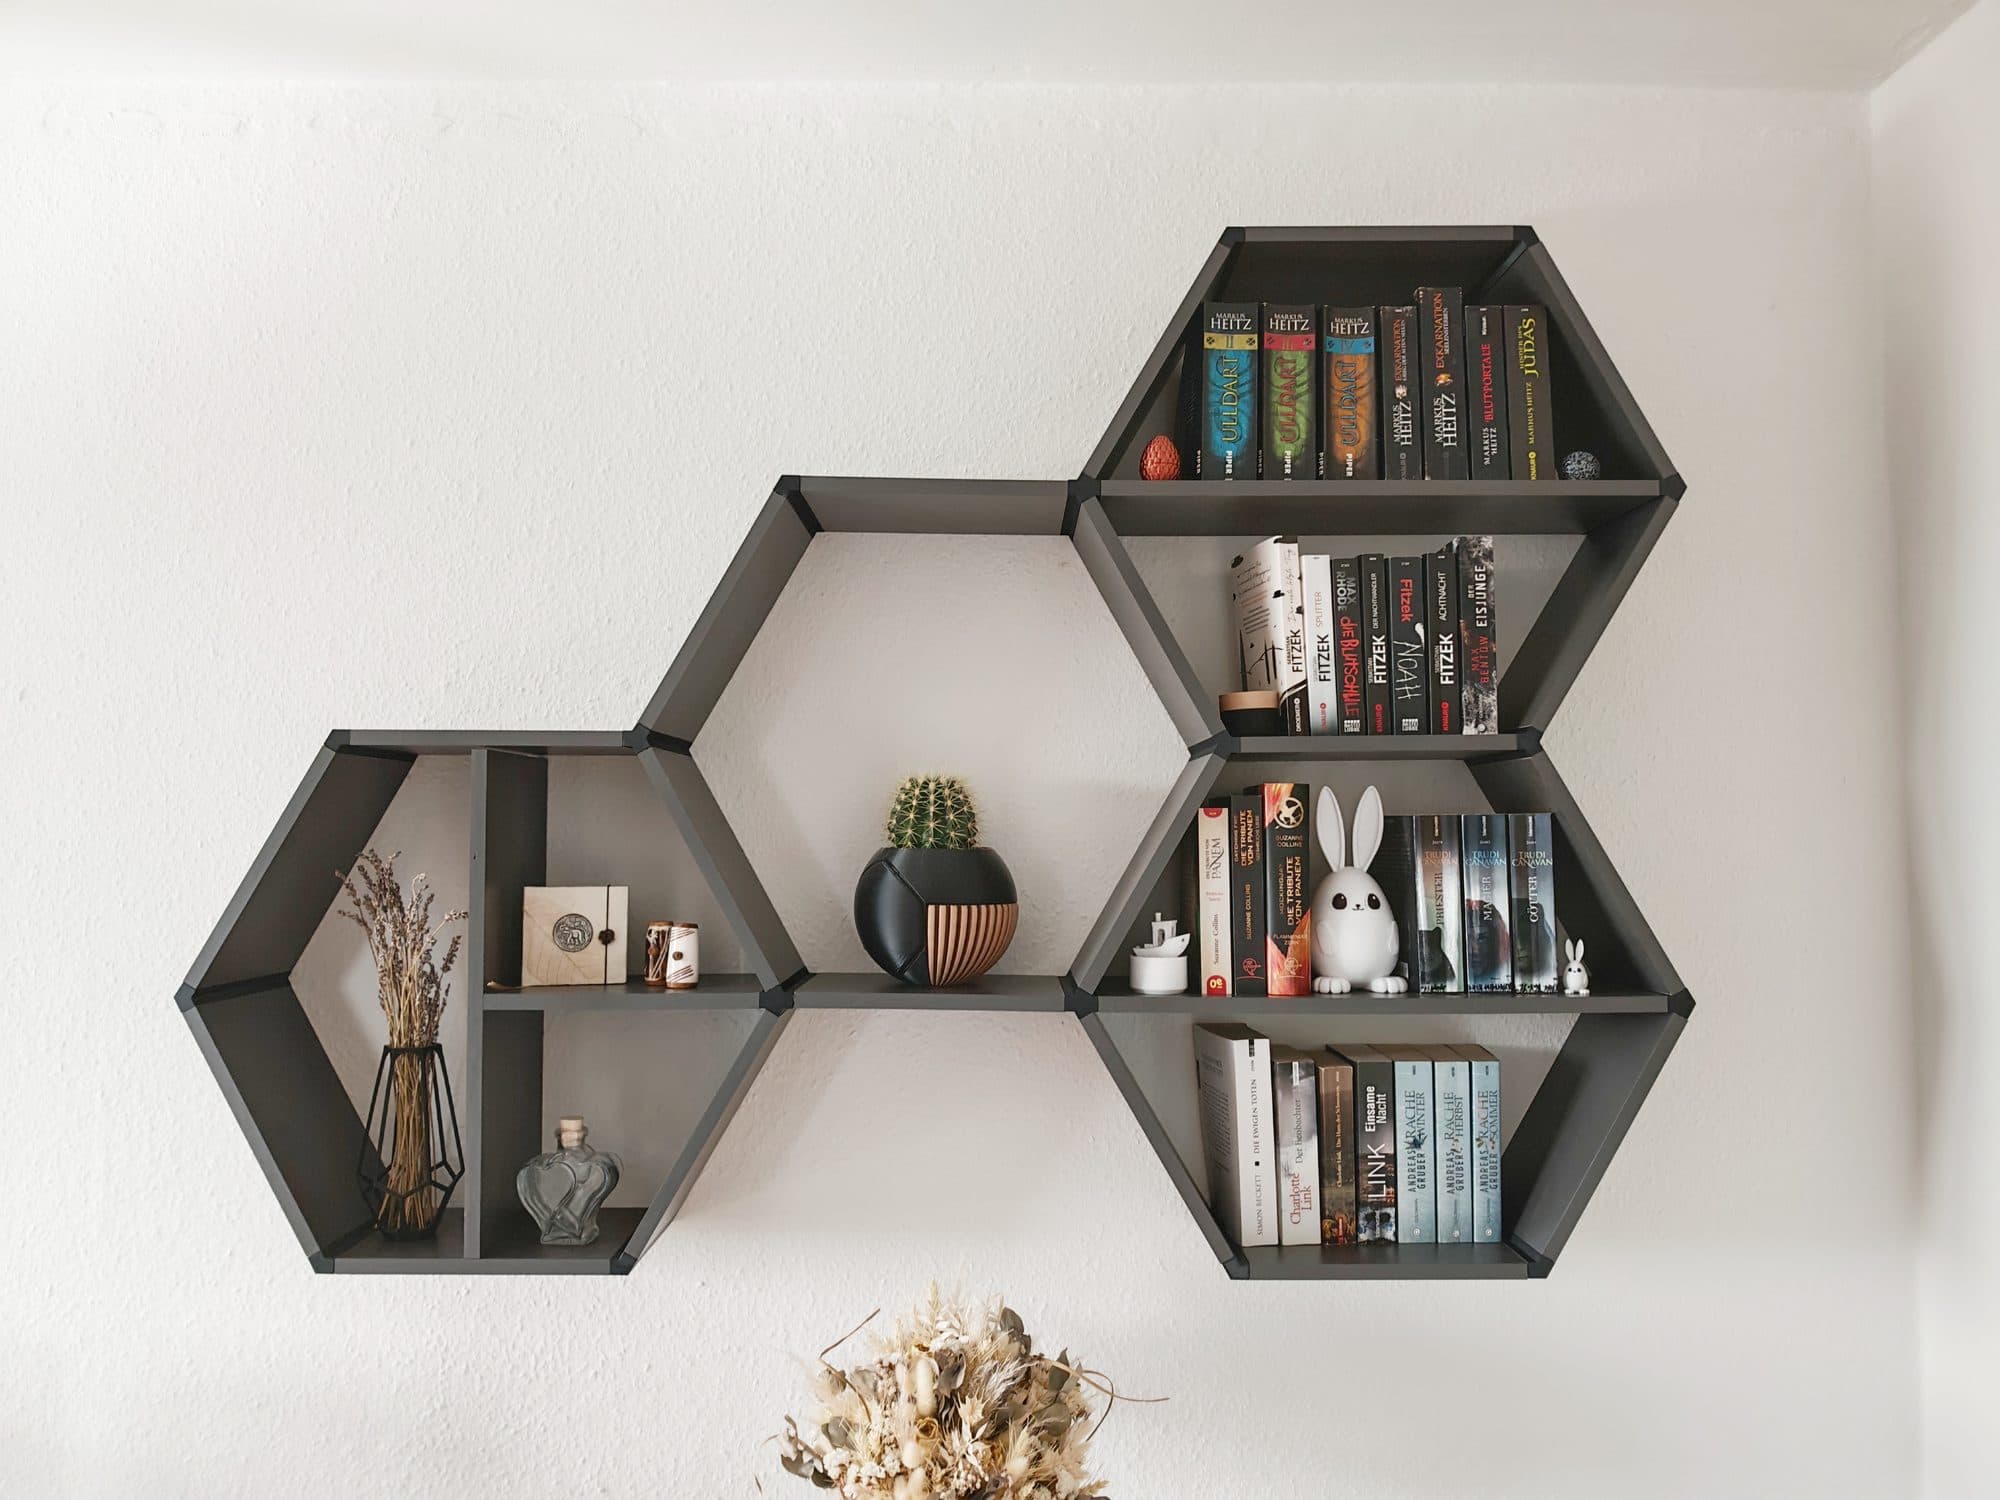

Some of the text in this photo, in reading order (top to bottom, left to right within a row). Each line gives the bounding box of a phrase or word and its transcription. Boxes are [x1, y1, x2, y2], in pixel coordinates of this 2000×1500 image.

[1211, 317, 1252, 330] HEITZ
[1269, 317, 1309, 331] HEITZ
[1330, 322, 1370, 335] HEITZ
[1433, 292, 1444, 369] EXKARNATION
[1521, 317, 1540, 378] JUDAS
[1222, 355, 1239, 443] ULLDART
[1480, 343, 1494, 423] BLUTPORTALE
[1392, 404, 1402, 443] MARKUS
[1400, 401, 1413, 446] HEITZ
[1433, 397, 1444, 444] MARKUS
[1441, 393, 1458, 448] HEITZ
[1525, 382, 1535, 444] MARKUS HEITZ
[1225, 450, 1233, 474] PIPER
[1482, 427, 1491, 465] MARKUS
[1490, 427, 1498, 455] HEITZ
[1314, 591, 1323, 628] SPLITTER
[1335, 571, 1347, 612] RHODE
[1347, 577, 1358, 604] MAX
[1399, 578, 1414, 623] Fitzek
[1437, 571, 1448, 622] ACHTNACHT
[1474, 565, 1488, 628] EISJUNGE
[1371, 617, 1379, 629] DER
[1290, 628, 1303, 673] FITZEK
[1317, 633, 1331, 682] FITZEK
[1372, 634, 1387, 684] FITZEK
[1393, 640, 1424, 700] NOAH
[1438, 633, 1455, 685] FITZEK
[1479, 635, 1489, 684] BENTOW
[1210, 838, 1224, 879] PANEM
[1294, 856, 1302, 897] PANEM
[1473, 851, 1500, 859] TRUDI
[1512, 857, 1553, 869] CANAVAN
[1519, 851, 1546, 859] TRUDI
[1286, 856, 1295, 926] DIE TRIBUTE
[1435, 872, 1445, 925] PRIESTER
[1527, 875, 1539, 923] GÖTTER
[1250, 1079, 1258, 1105] TOTEN
[1365, 1085, 1376, 1133] Einsame
[1375, 1093, 1387, 1124] Nacht
[1415, 1092, 1424, 1136] WINTER
[1478, 1090, 1488, 1138] RACHE
[1251, 1107, 1260, 1138] EWIGEN
[1293, 1098, 1304, 1164] Der Beobachter
[1405, 1090, 1416, 1139] RACHE
[1443, 1092, 1455, 1141] RACHE
[1454, 1095, 1464, 1137] HERBST
[1488, 1090, 1498, 1139] SOMMER
[1252, 1140, 1260, 1154] DIE
[1367, 1143, 1386, 1200] LINK
[1407, 1150, 1417, 1193] ANDREAS
[1416, 1152, 1426, 1190] GRUBER
[1446, 1152, 1456, 1194] ANDREAS
[1455, 1154, 1465, 1191] GRUBER
[1479, 1150, 1489, 1193] ANDREAS
[1489, 1153, 1498, 1190] GRUBER
[1254, 1174, 1263, 1236] SIMON BECKETT
[1288, 1173, 1301, 1225] Charlotte
[1301, 1185, 1312, 1211] Link
